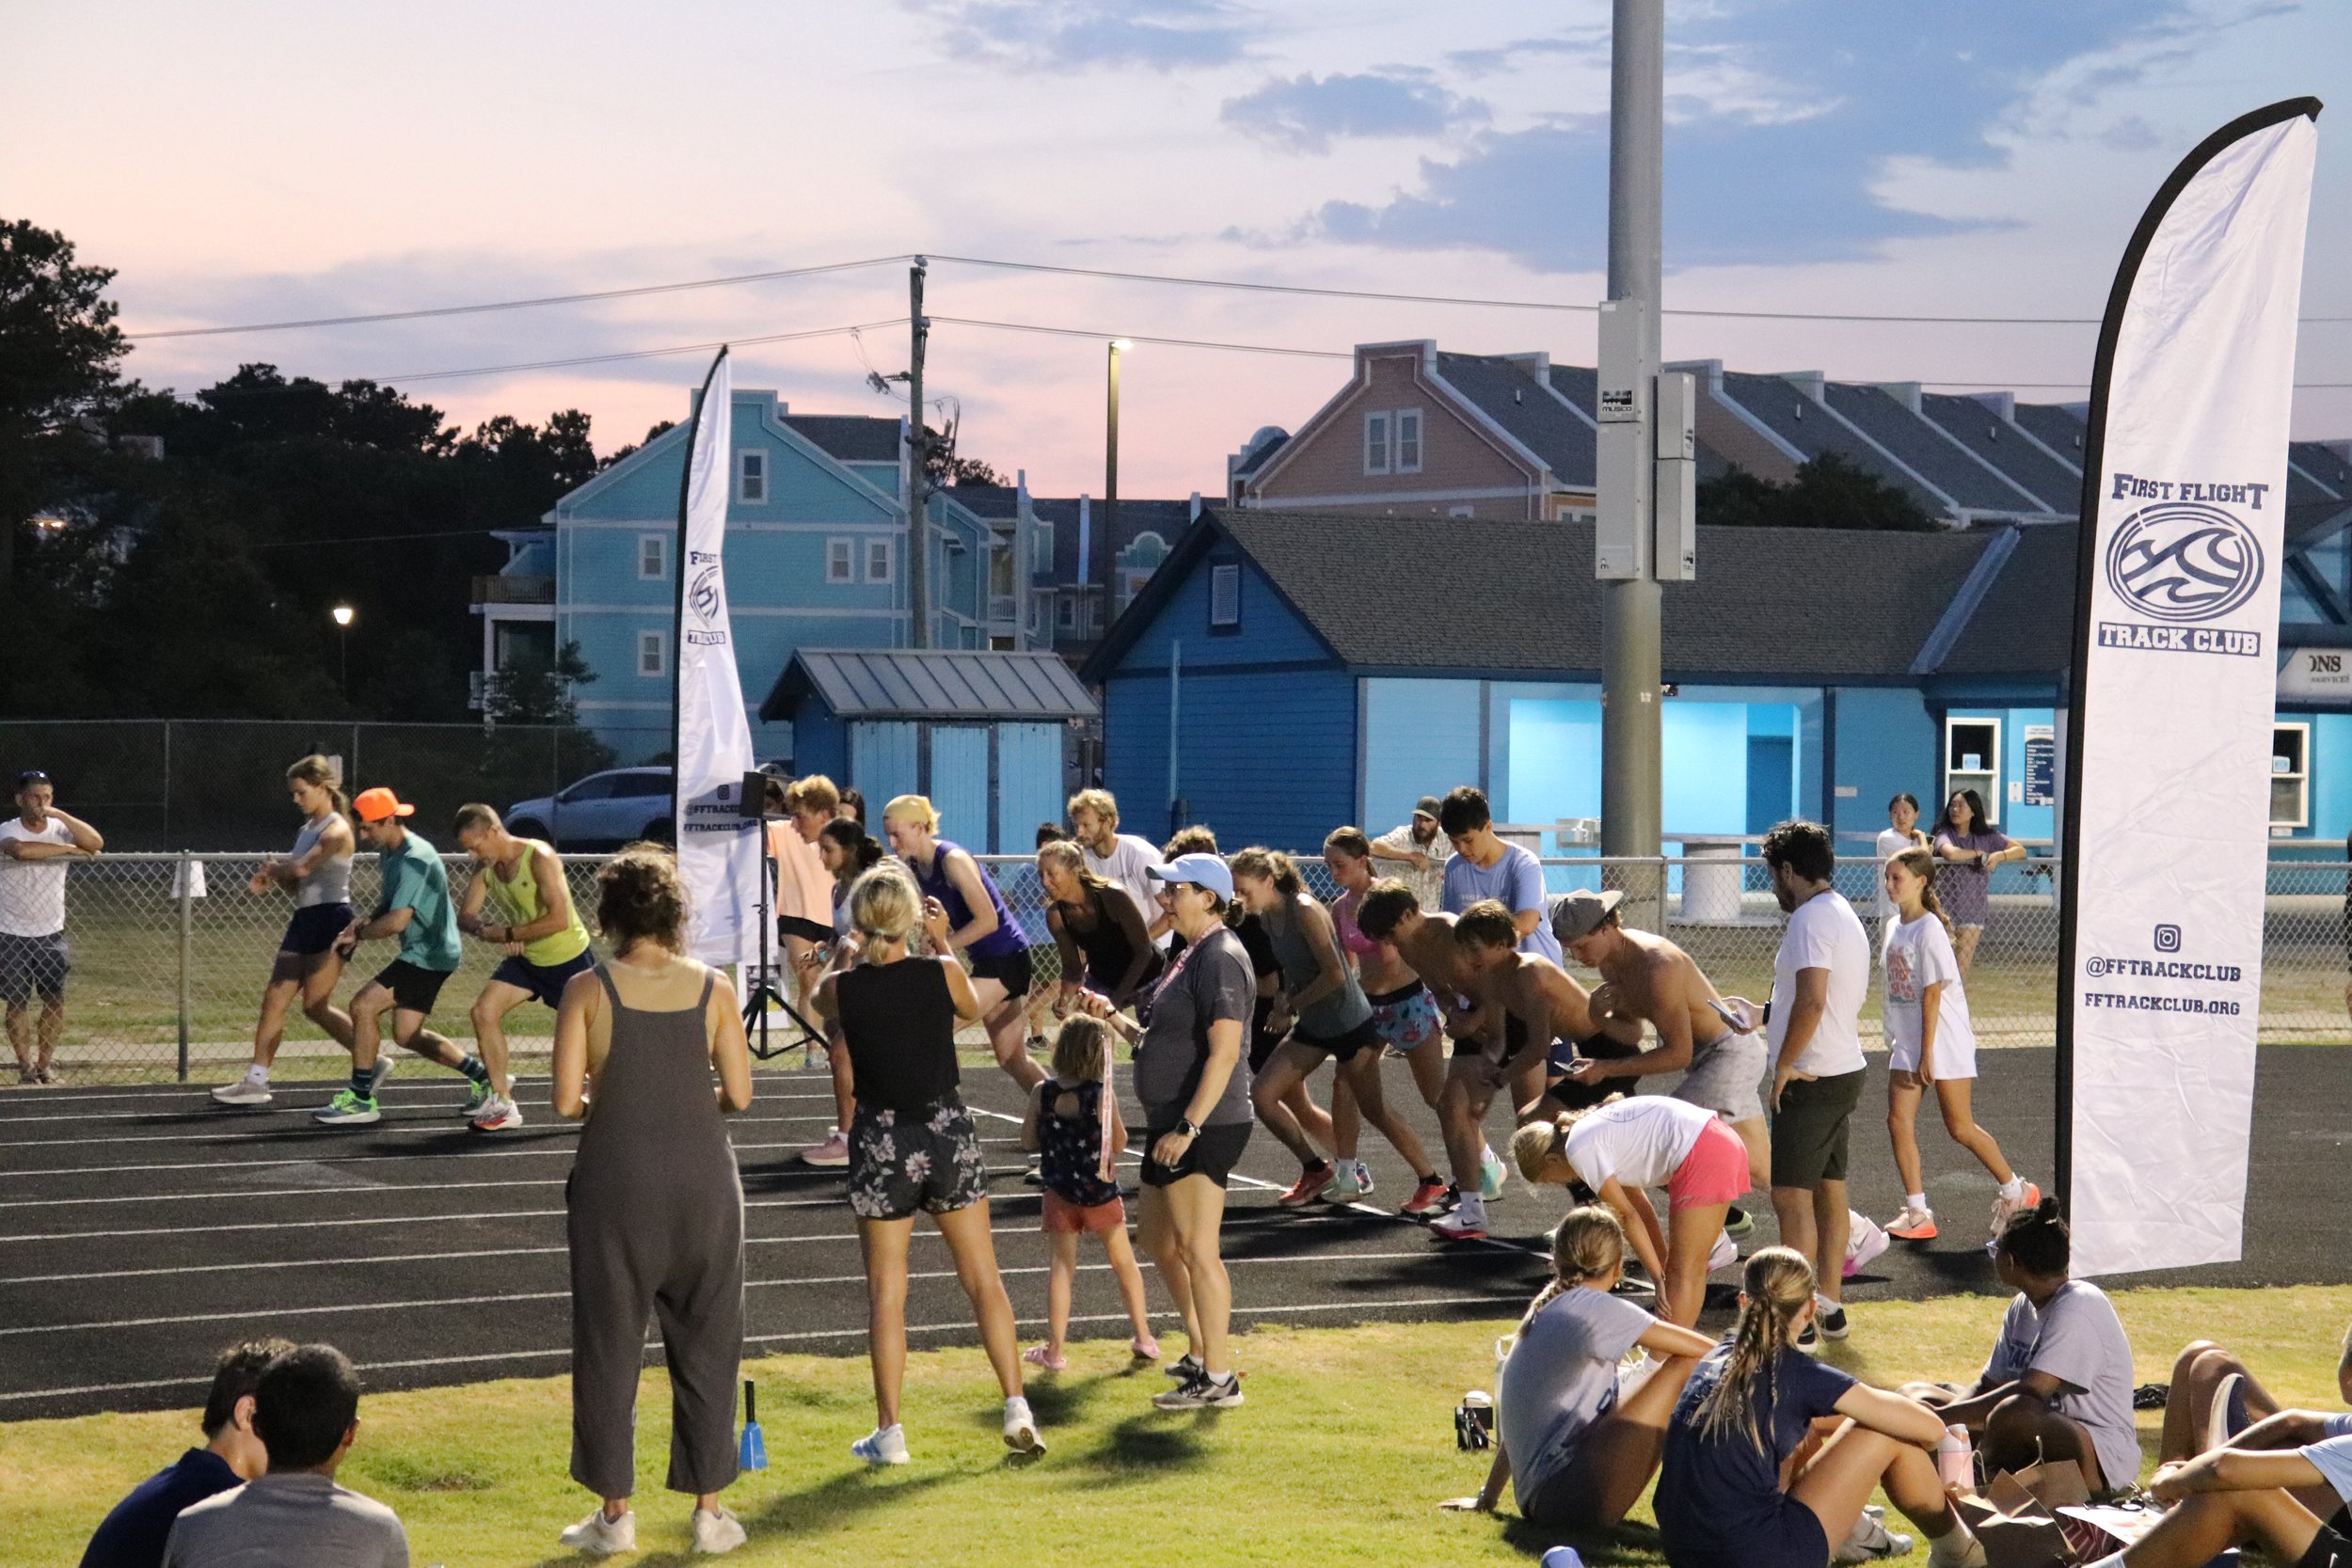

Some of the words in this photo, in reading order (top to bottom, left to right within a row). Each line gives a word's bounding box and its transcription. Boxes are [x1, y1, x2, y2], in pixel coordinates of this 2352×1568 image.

[2111, 472, 2173, 500] FIRST
[2179, 483, 2269, 510] FLIGHT
[2101, 624, 2188, 650] TRACK
[2194, 629, 2258, 655] CLUB
[2086, 956, 2242, 982] @FFTRACKCLUB
[2085, 992, 2241, 1016] FFTRACKCLUB.ORG
